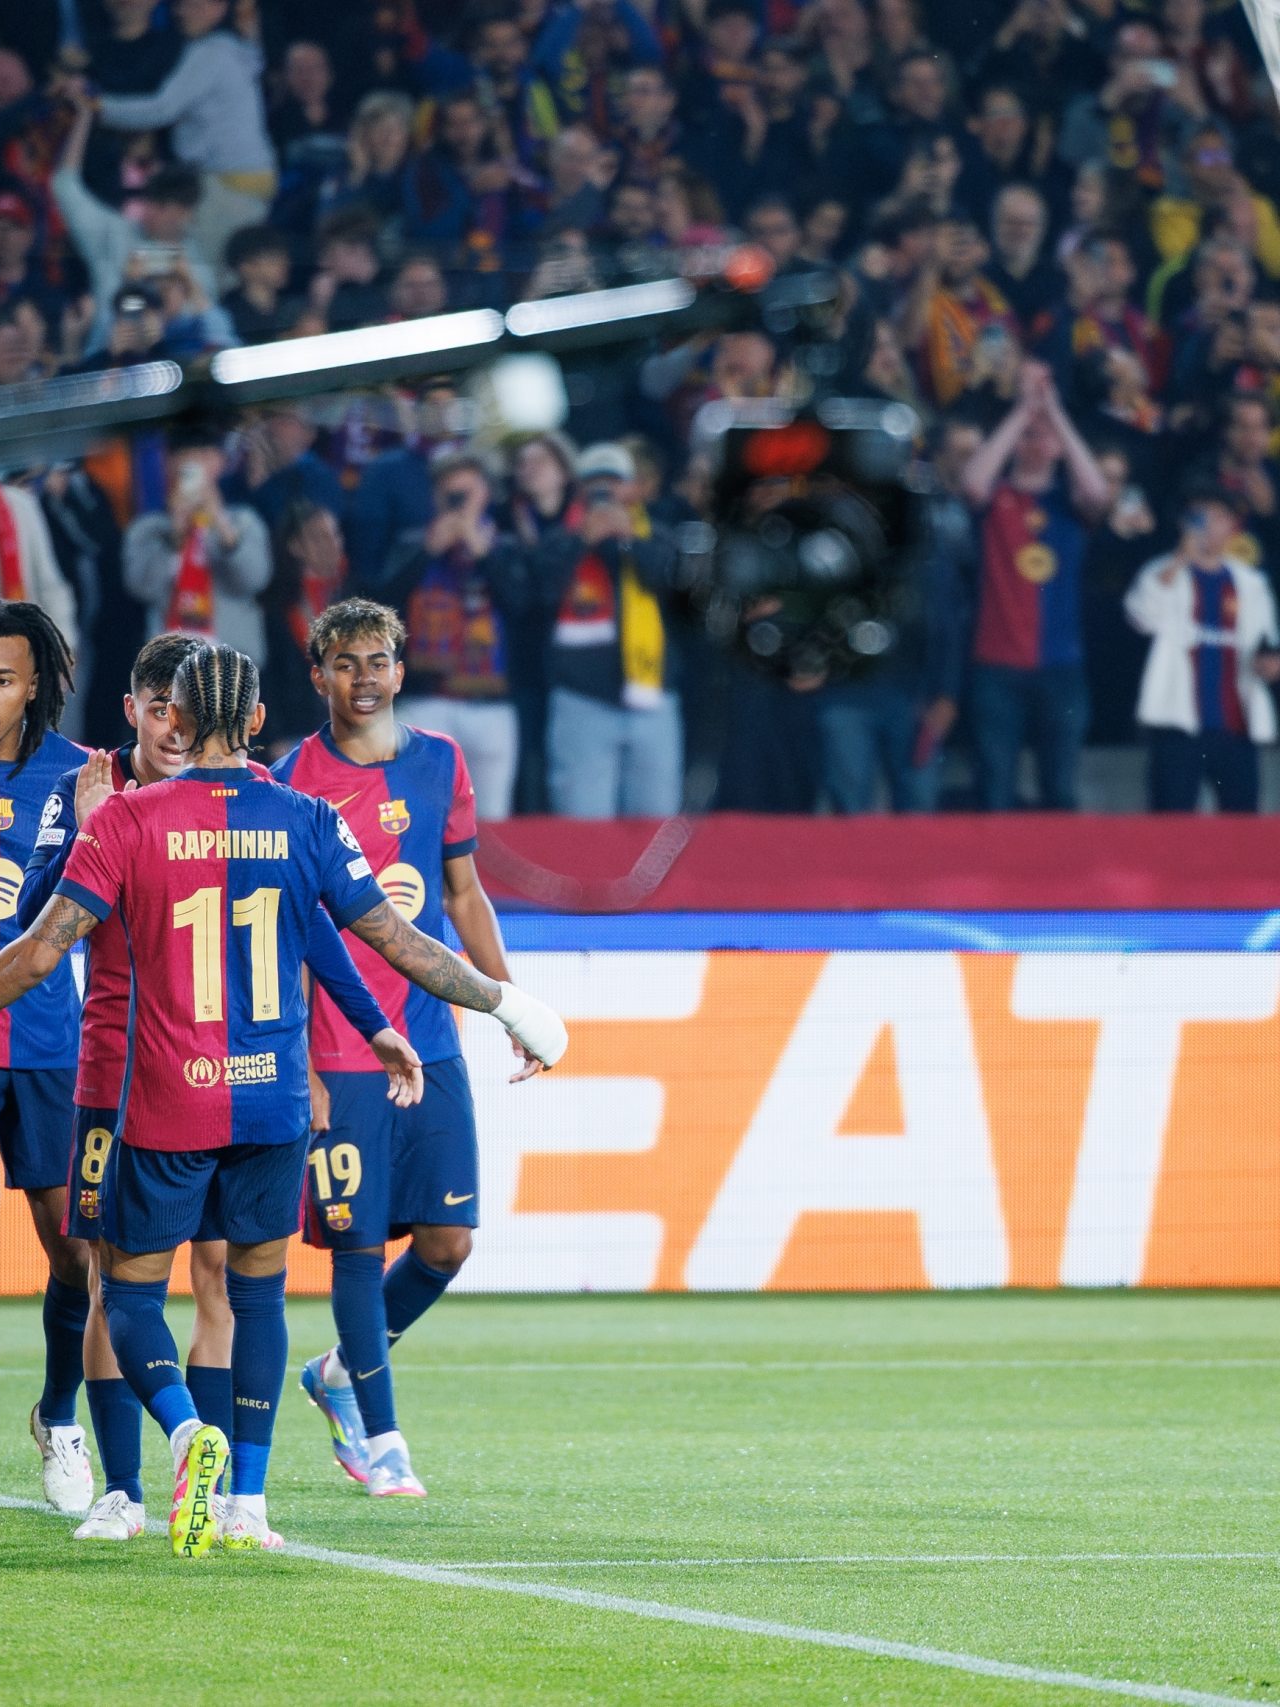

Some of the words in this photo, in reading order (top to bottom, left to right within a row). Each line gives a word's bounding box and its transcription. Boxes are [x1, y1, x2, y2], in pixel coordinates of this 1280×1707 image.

[166, 829, 289, 861] RAPHINHA
[173, 886, 282, 1022] 11
[223, 1052, 276, 1069] UNHCR
[224, 1064, 277, 1081] ACNUR
[442, 951, 1280, 1292] EAT
[81, 1127, 113, 1184] 8
[308, 1143, 362, 1200] 19
